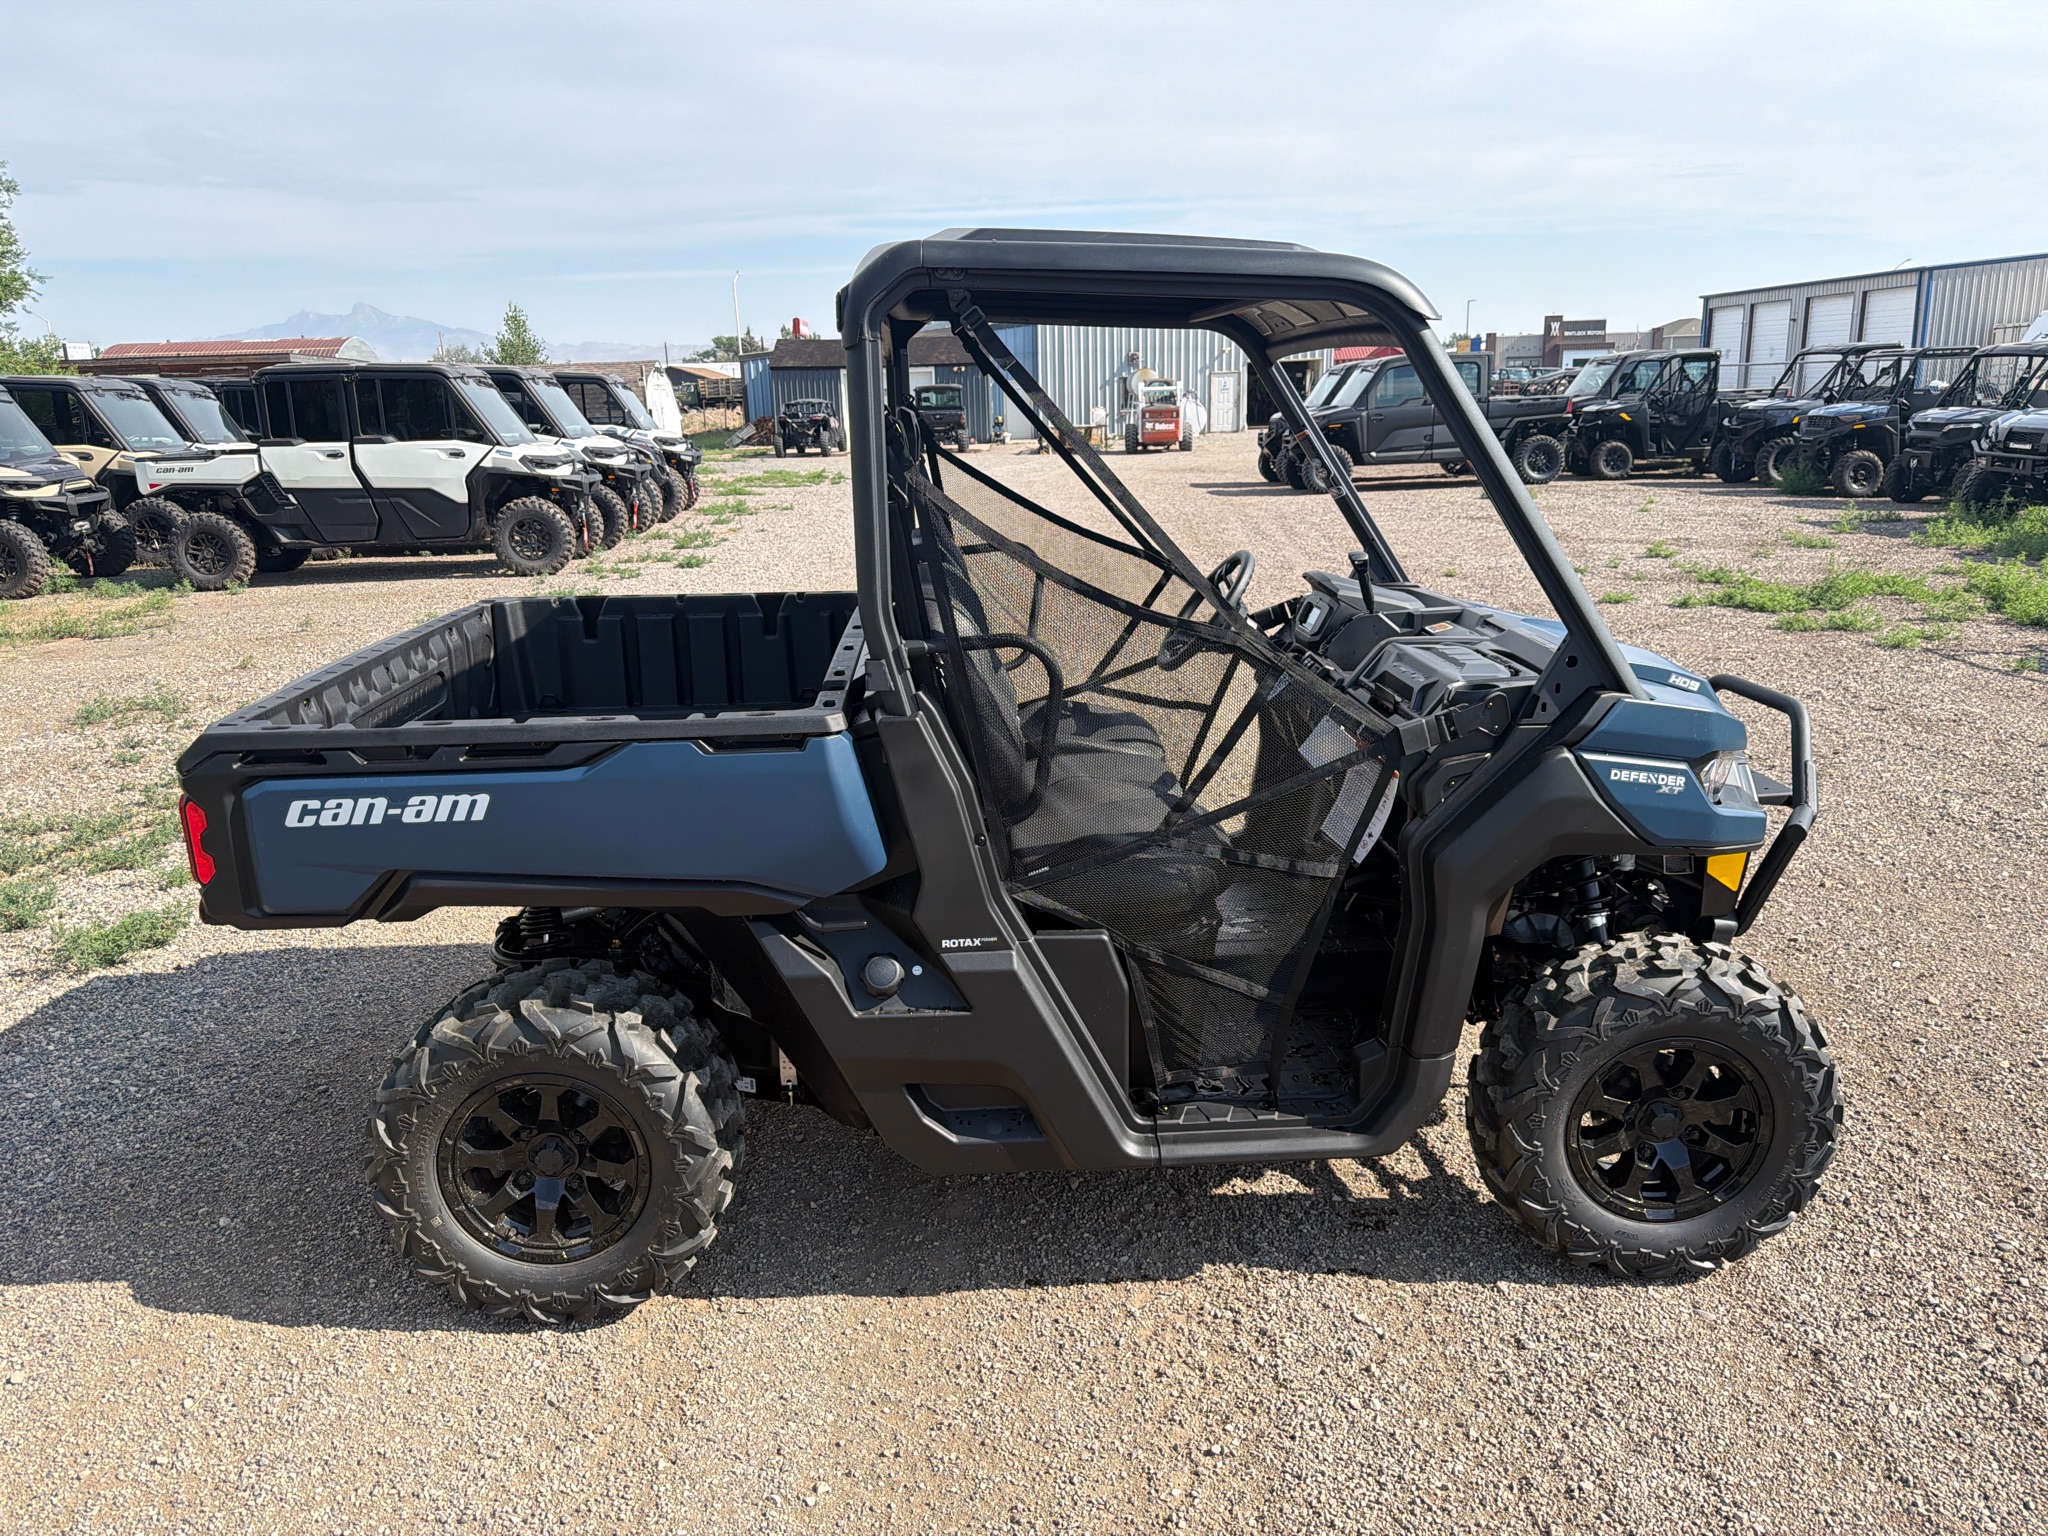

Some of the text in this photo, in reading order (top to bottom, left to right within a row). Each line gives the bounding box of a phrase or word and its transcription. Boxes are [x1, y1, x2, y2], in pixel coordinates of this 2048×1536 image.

[1155, 422, 1175, 430] Bobcat
[156, 466, 194, 474] can-am
[1668, 672, 1700, 692] HD9
[1610, 769, 1686, 787] DEFENDER
[1657, 785, 1684, 795] XT
[285, 793, 490, 828] can-am
[941, 938, 981, 948] ROTAX
